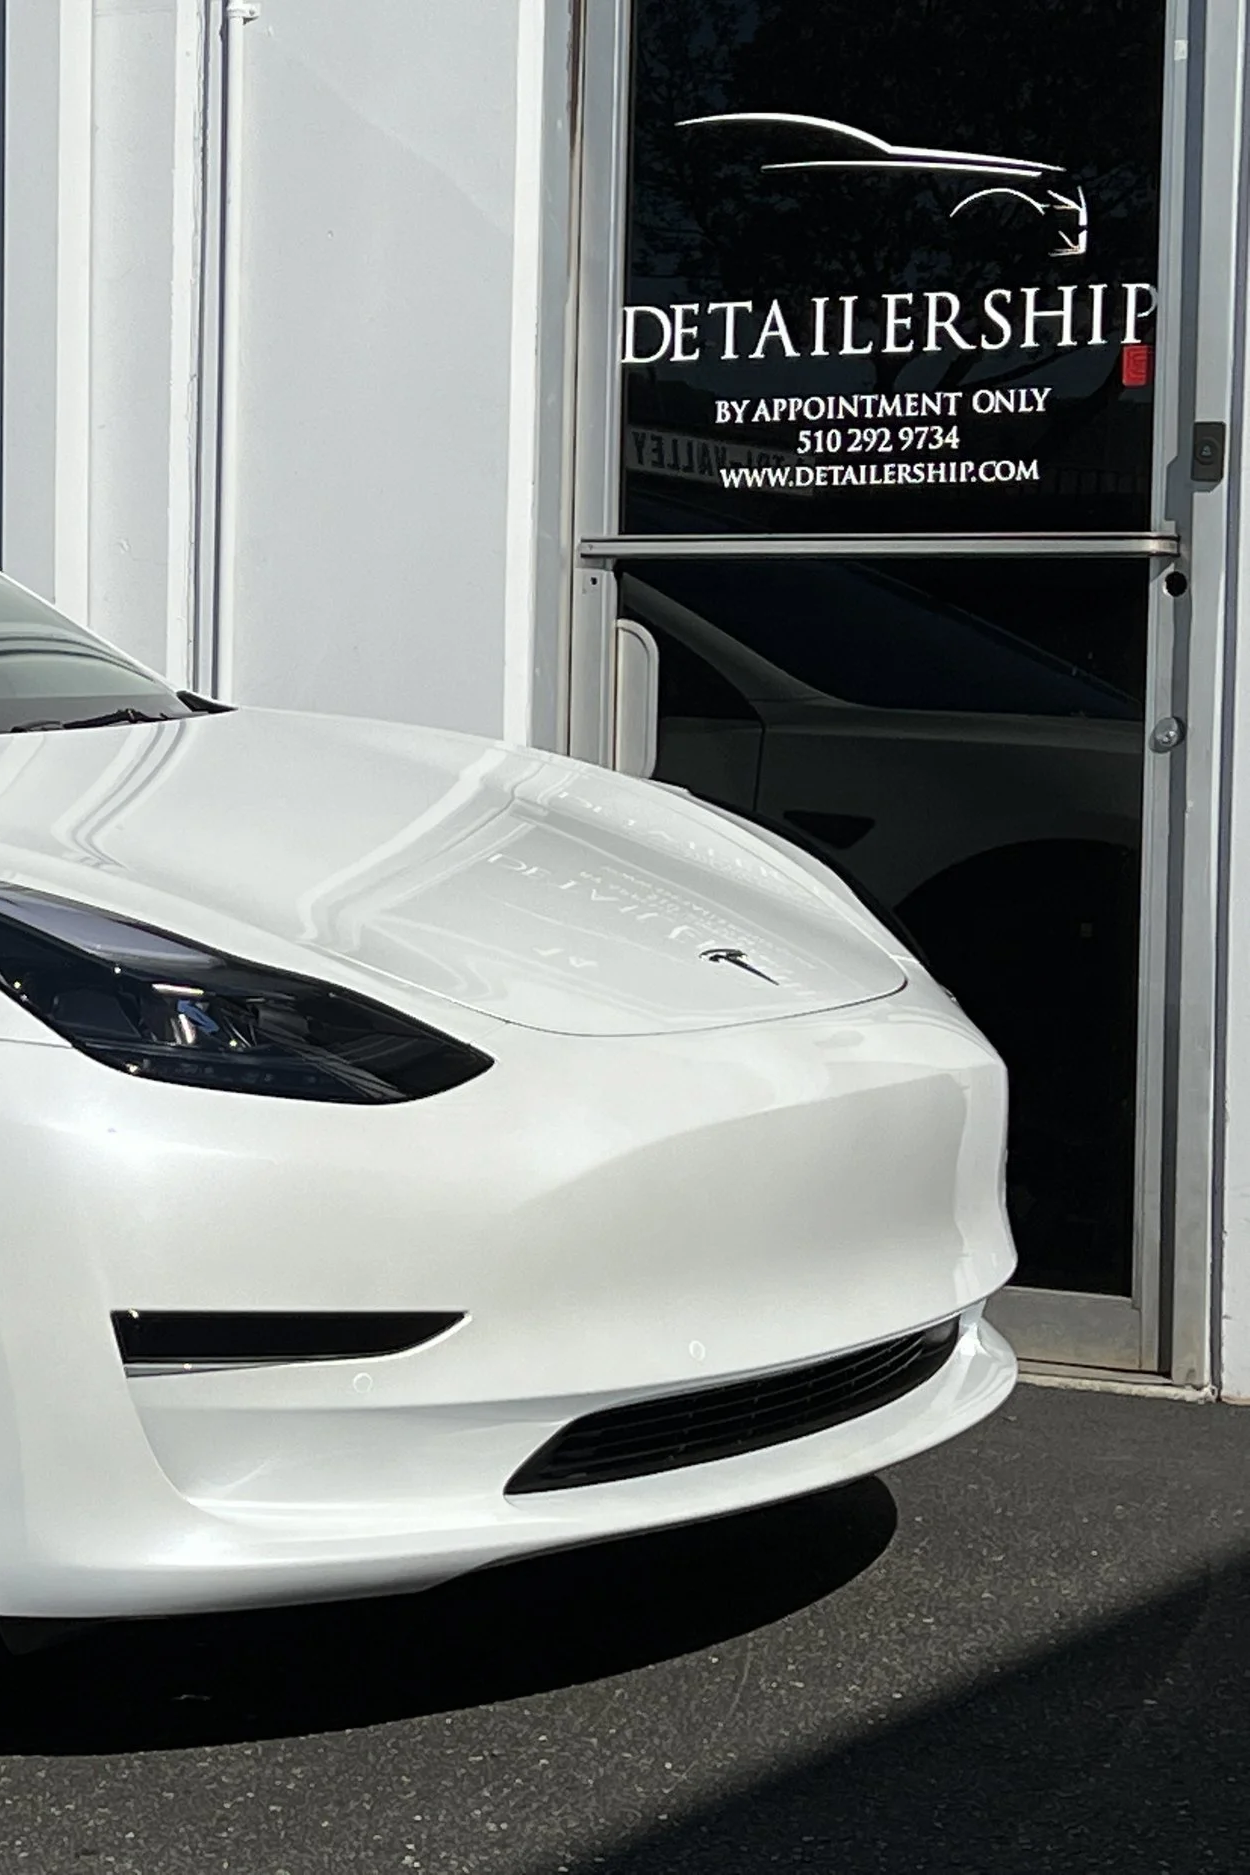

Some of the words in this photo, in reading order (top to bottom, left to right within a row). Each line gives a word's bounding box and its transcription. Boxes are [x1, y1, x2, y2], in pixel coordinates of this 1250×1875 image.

[621, 283, 1157, 364] DETAILERSHIP
[715, 400, 750, 424] BY
[751, 391, 962, 423] APPOINTMENT
[972, 387, 1052, 414] ONLY
[796, 429, 842, 454] 510
[847, 426, 893, 452] 292
[898, 424, 960, 451] 9734
[719, 459, 1040, 489] WWW.DETAILERSHIP.COM
